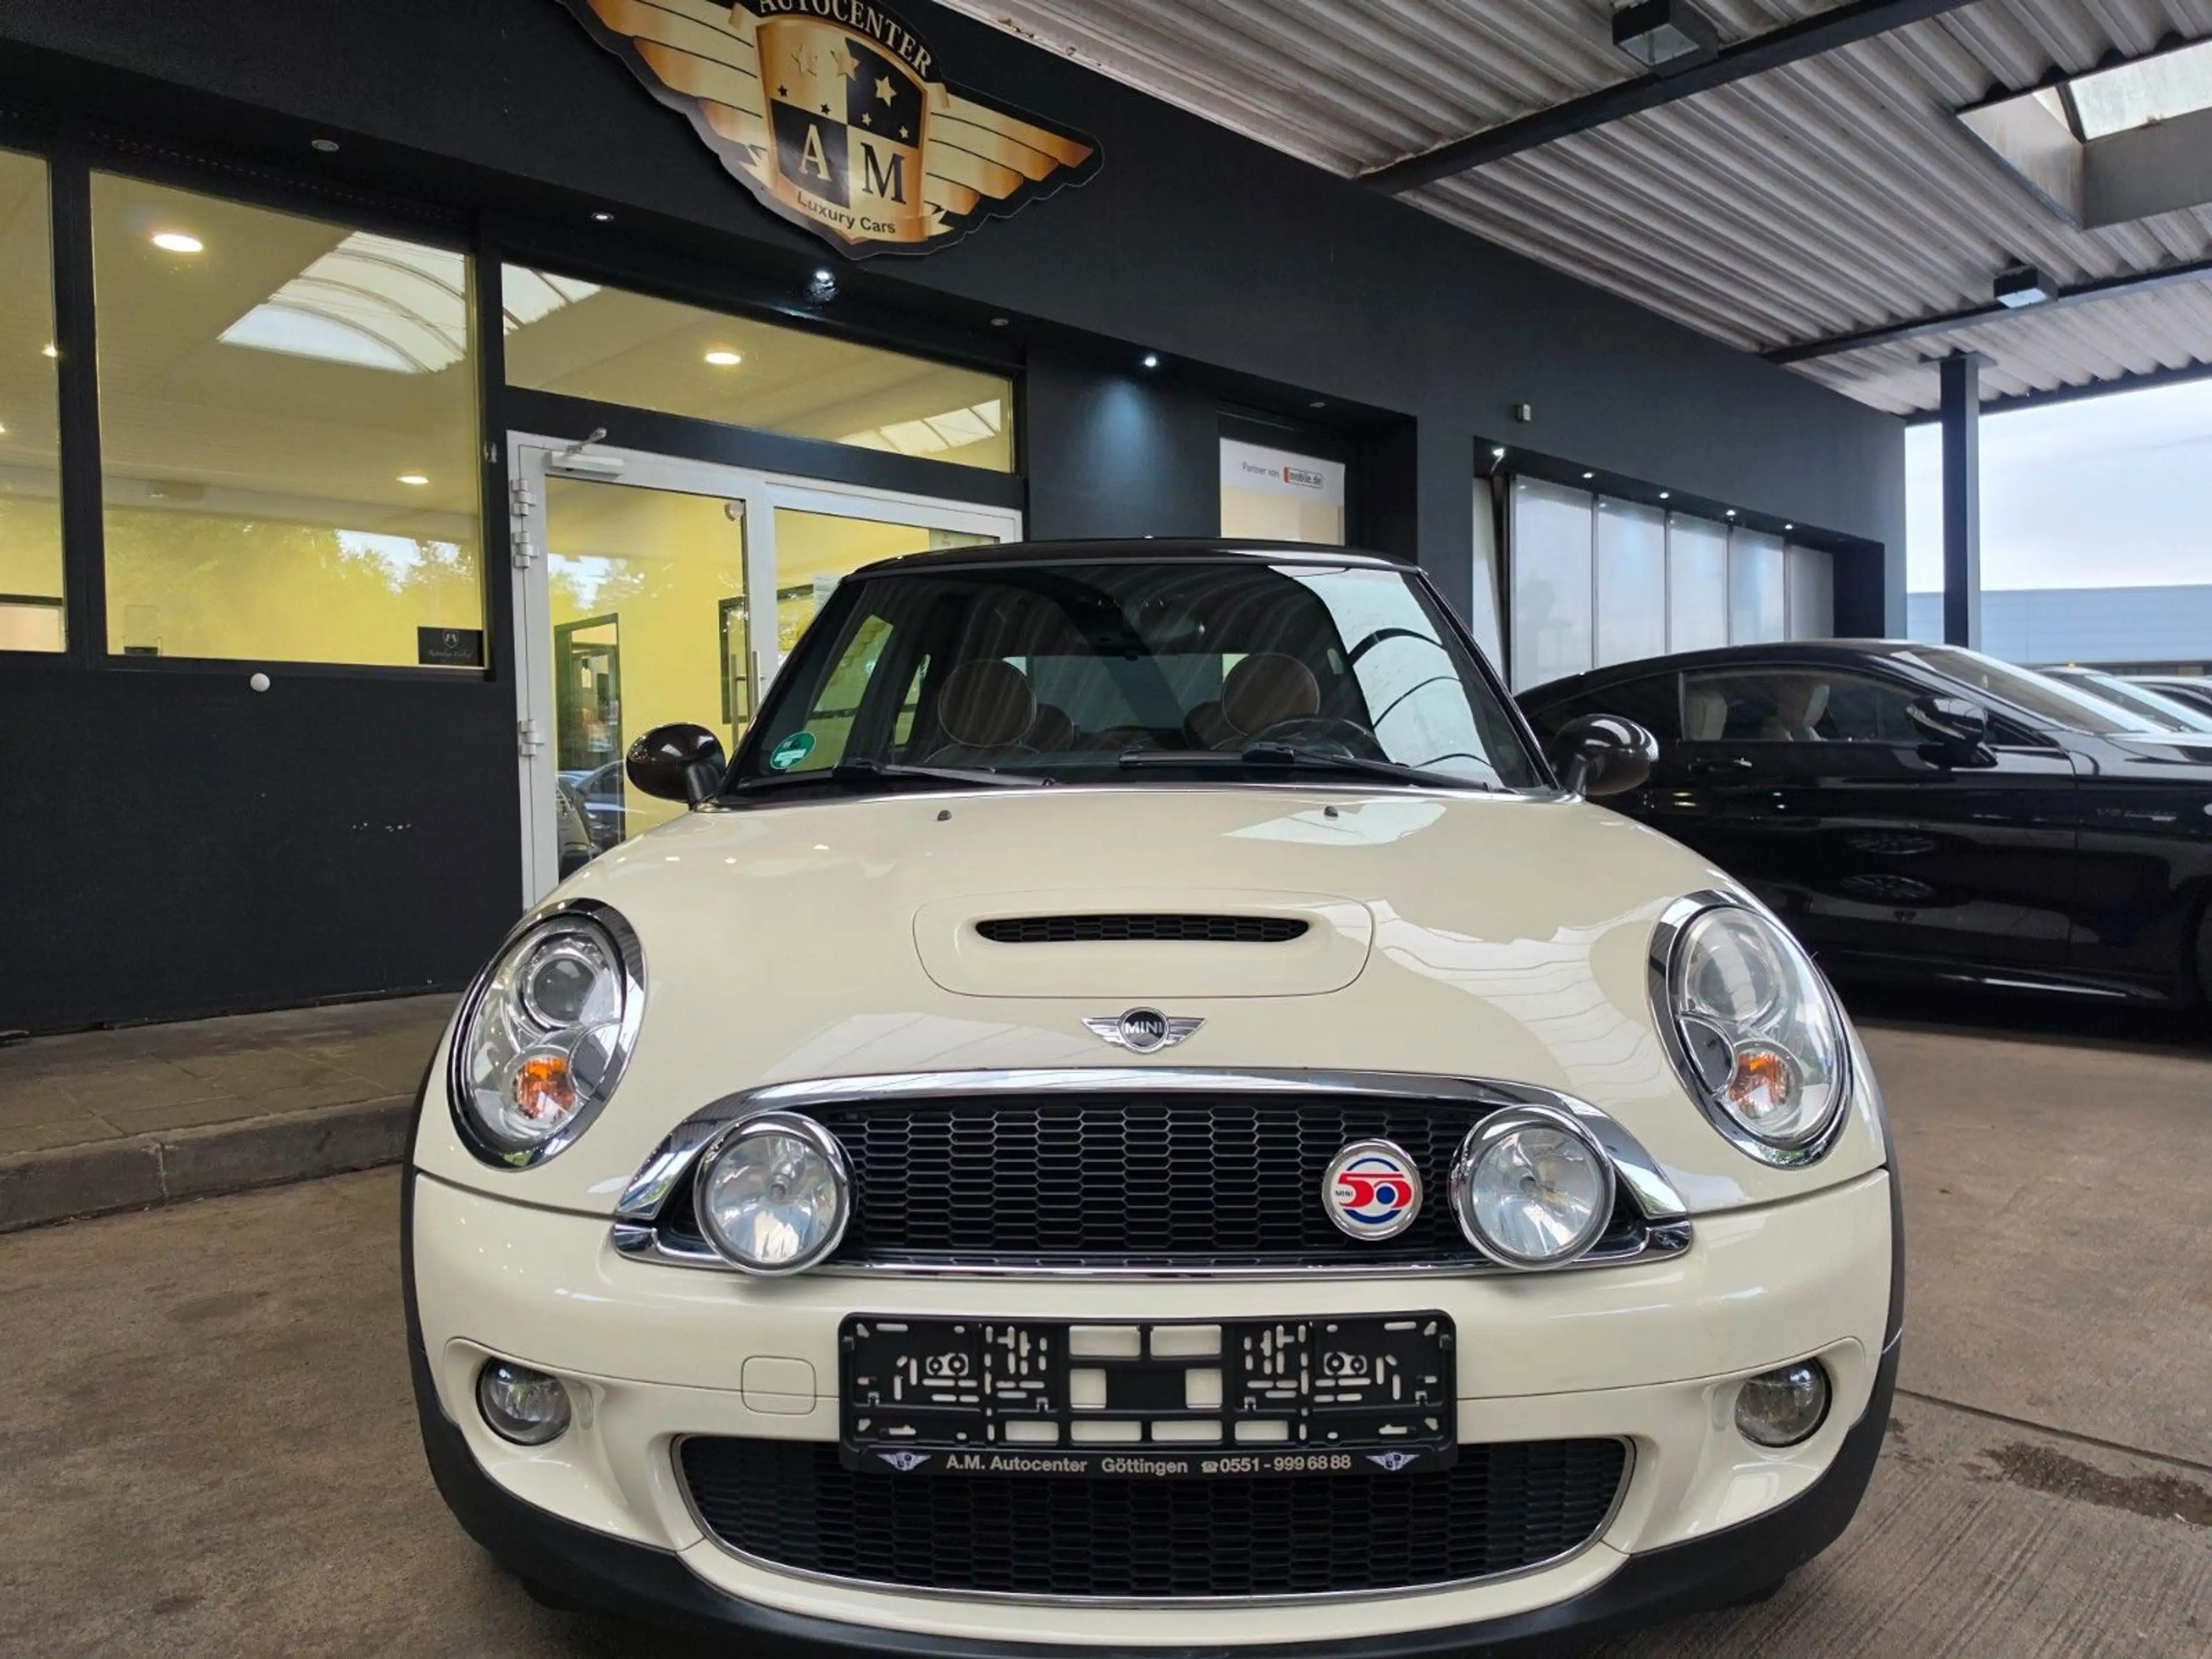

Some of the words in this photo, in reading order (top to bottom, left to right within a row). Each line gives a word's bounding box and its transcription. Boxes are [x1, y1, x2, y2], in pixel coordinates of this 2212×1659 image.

[798, 123, 831, 181] A
[860, 141, 906, 204] M
[797, 191, 855, 229] Luxury
[860, 217, 896, 233] Cars
[1125, 1021, 1162, 1034] MINI
[946, 1454, 986, 1469] A.M.
[990, 1455, 1088, 1472] Autocenter
[1101, 1457, 1188, 1476] Göttingen
[1219, 1457, 1260, 1472] 0551
